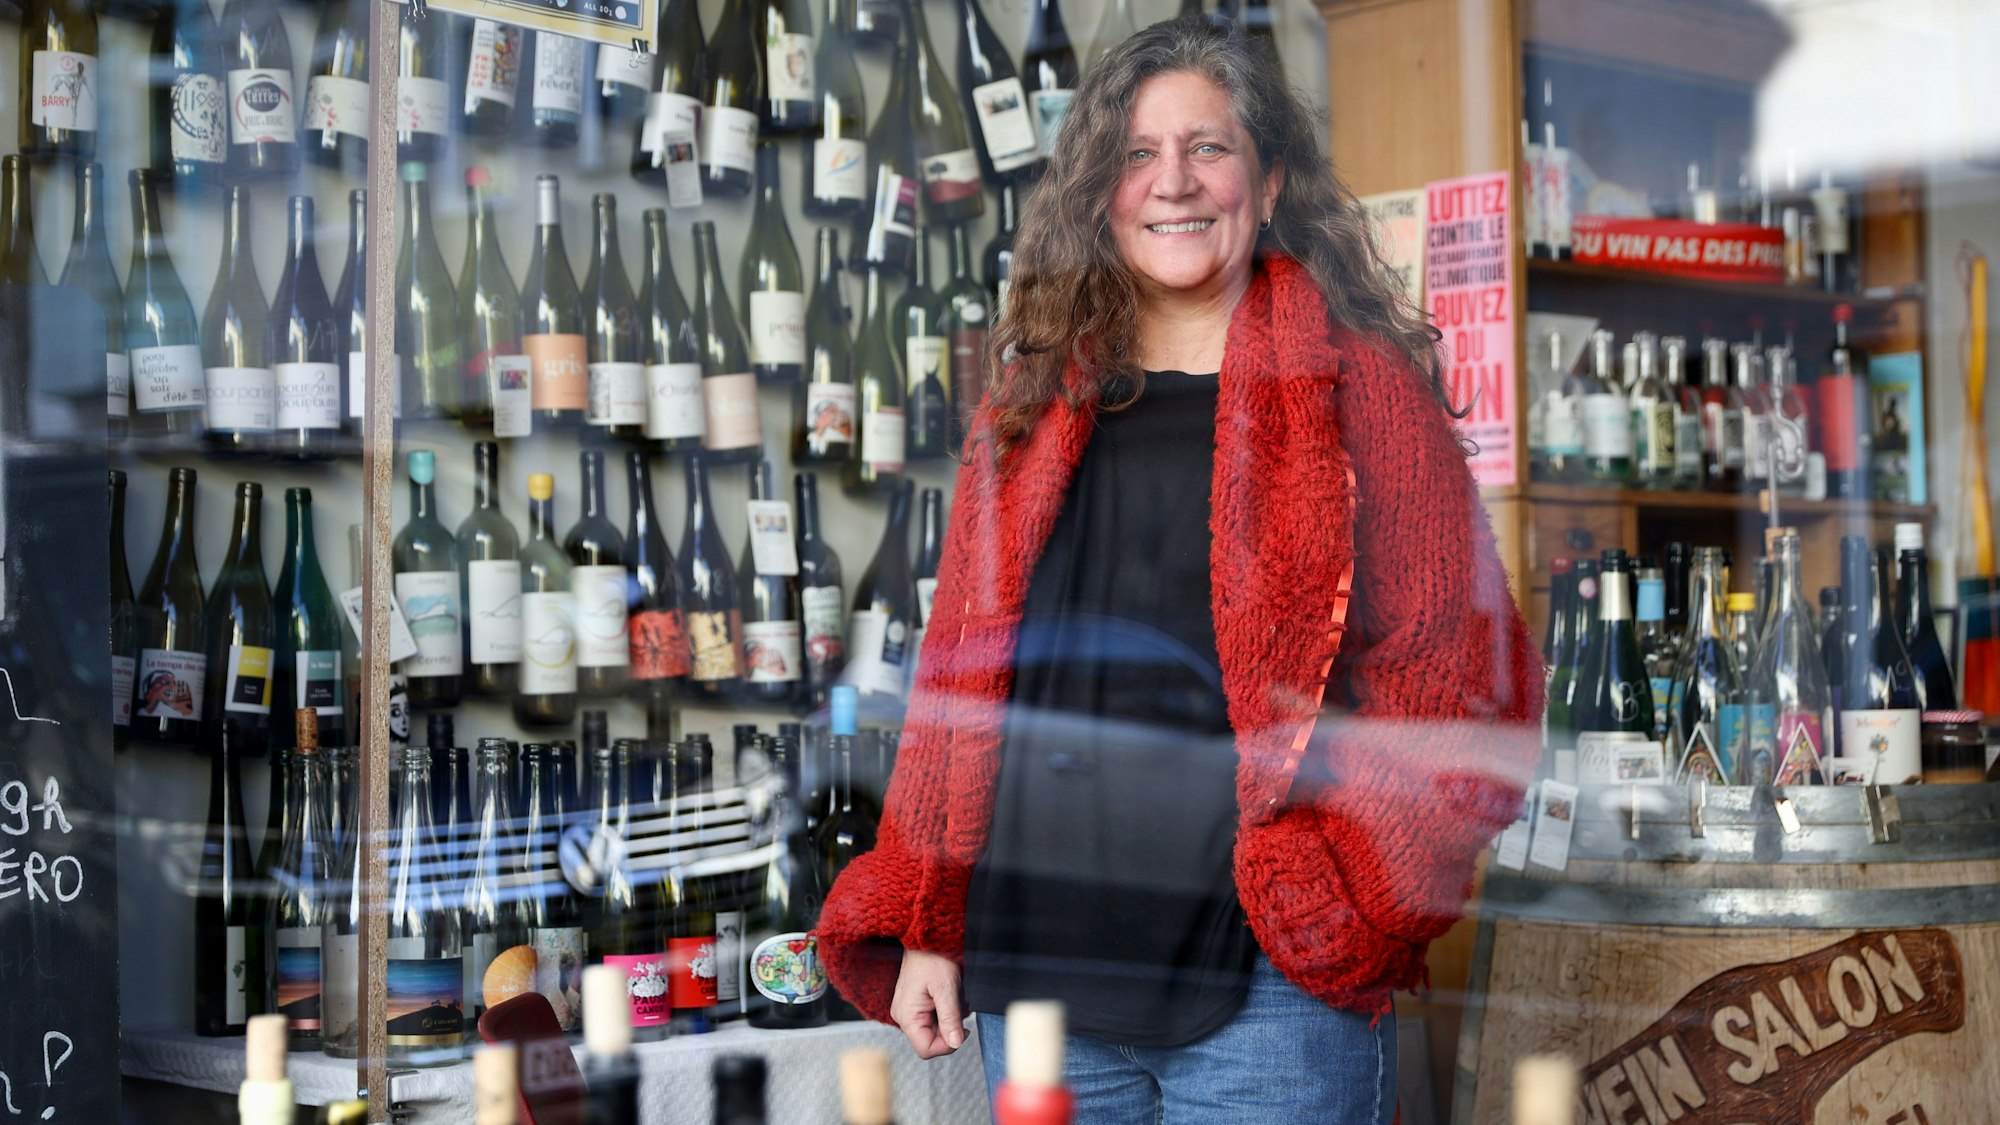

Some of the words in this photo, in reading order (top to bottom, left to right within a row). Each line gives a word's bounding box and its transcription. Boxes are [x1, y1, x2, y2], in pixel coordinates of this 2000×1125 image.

[584, 2, 597, 11] ALL
[42, 95, 70, 107] BARRY
[1428, 180, 1505, 224] LUTTEZ
[1428, 220, 1483, 248] CONTRE
[1489, 216, 1504, 240] LE
[1606, 234, 1652, 260] VIN
[1652, 236, 1700, 263] PAS
[1703, 239, 1747, 266] DES
[1430, 261, 1505, 288] CLIMATIQUE
[1434, 288, 1505, 328] BUVEZ
[1456, 330, 1484, 363] DU
[543, 352, 582, 381] gris
[150, 384, 171, 394] soir
[1446, 364, 1504, 424] VIN
[636, 1005, 664, 1015] CANON
[1711, 933, 1926, 1085] SALON
